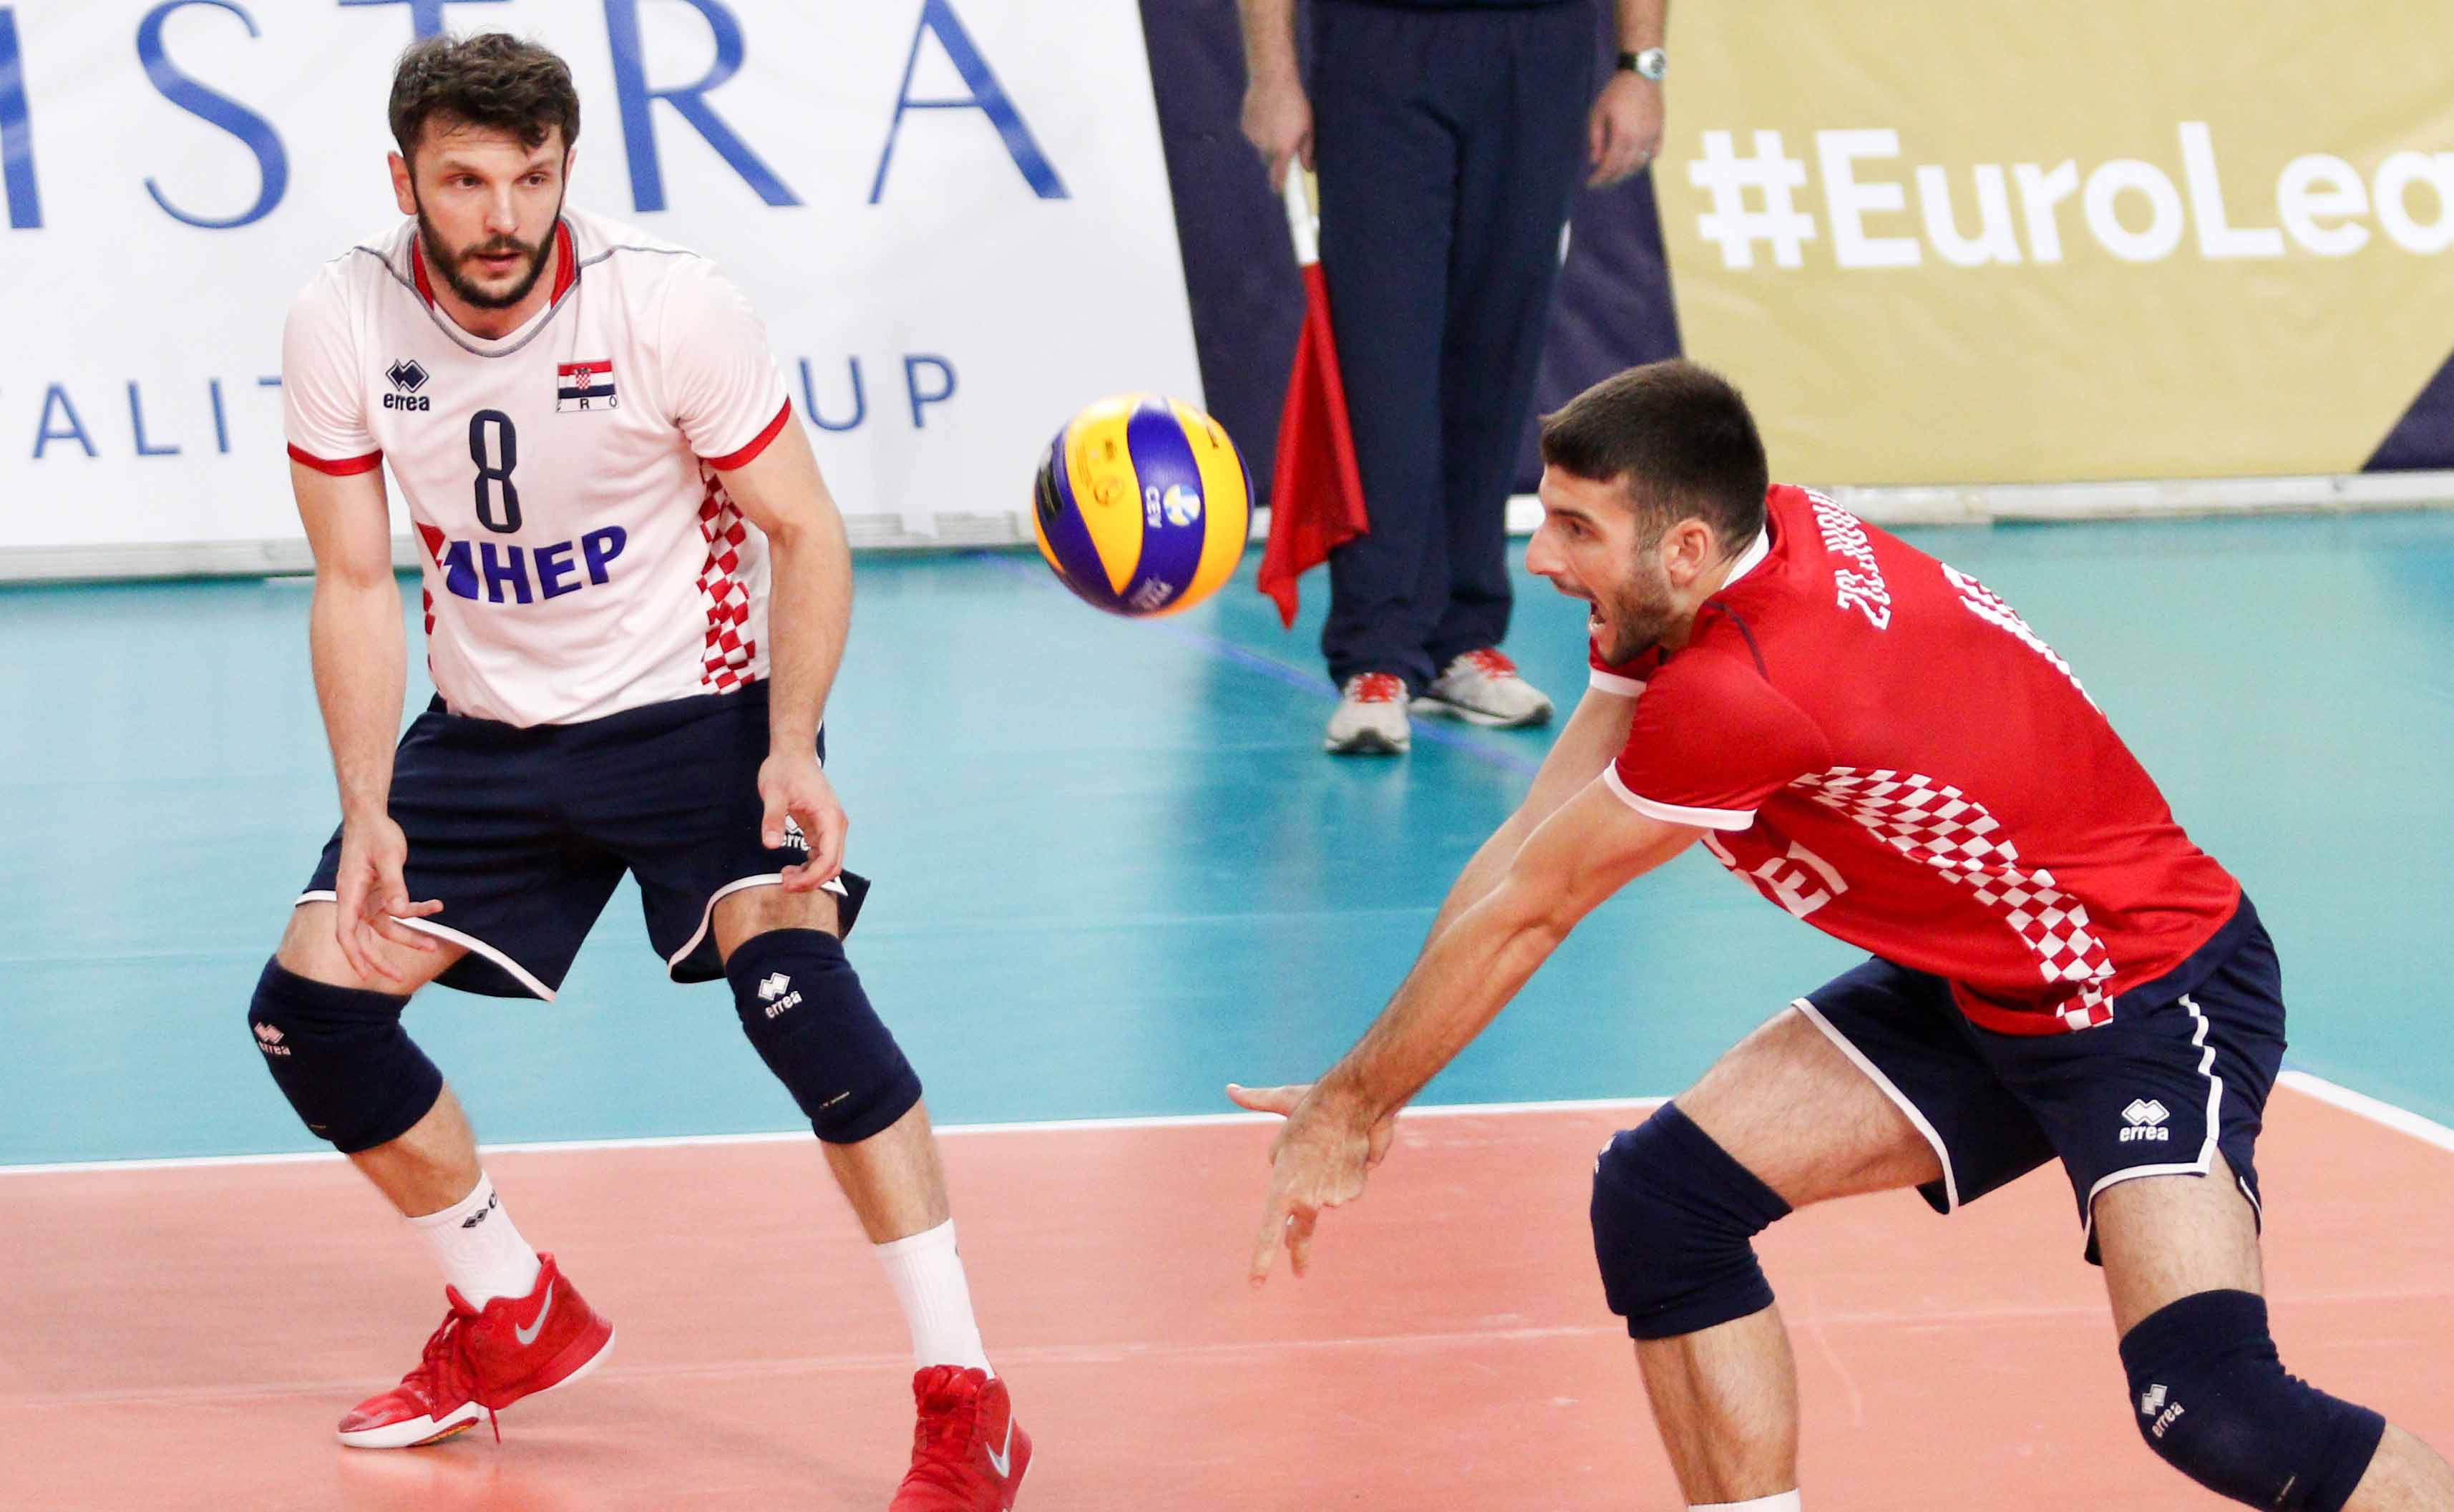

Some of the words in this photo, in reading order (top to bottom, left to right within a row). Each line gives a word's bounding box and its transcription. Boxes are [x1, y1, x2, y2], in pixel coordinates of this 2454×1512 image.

[0, 0, 1071, 229] ISRA
[33, 376, 282, 459] ALI
[383, 392, 429, 411] errea
[469, 409, 522, 534] 8
[479, 525, 628, 605] HEP
[764, 990, 802, 1019] errea
[2119, 1126, 2168, 1142] errea
[2152, 1402, 2184, 1438] errea
